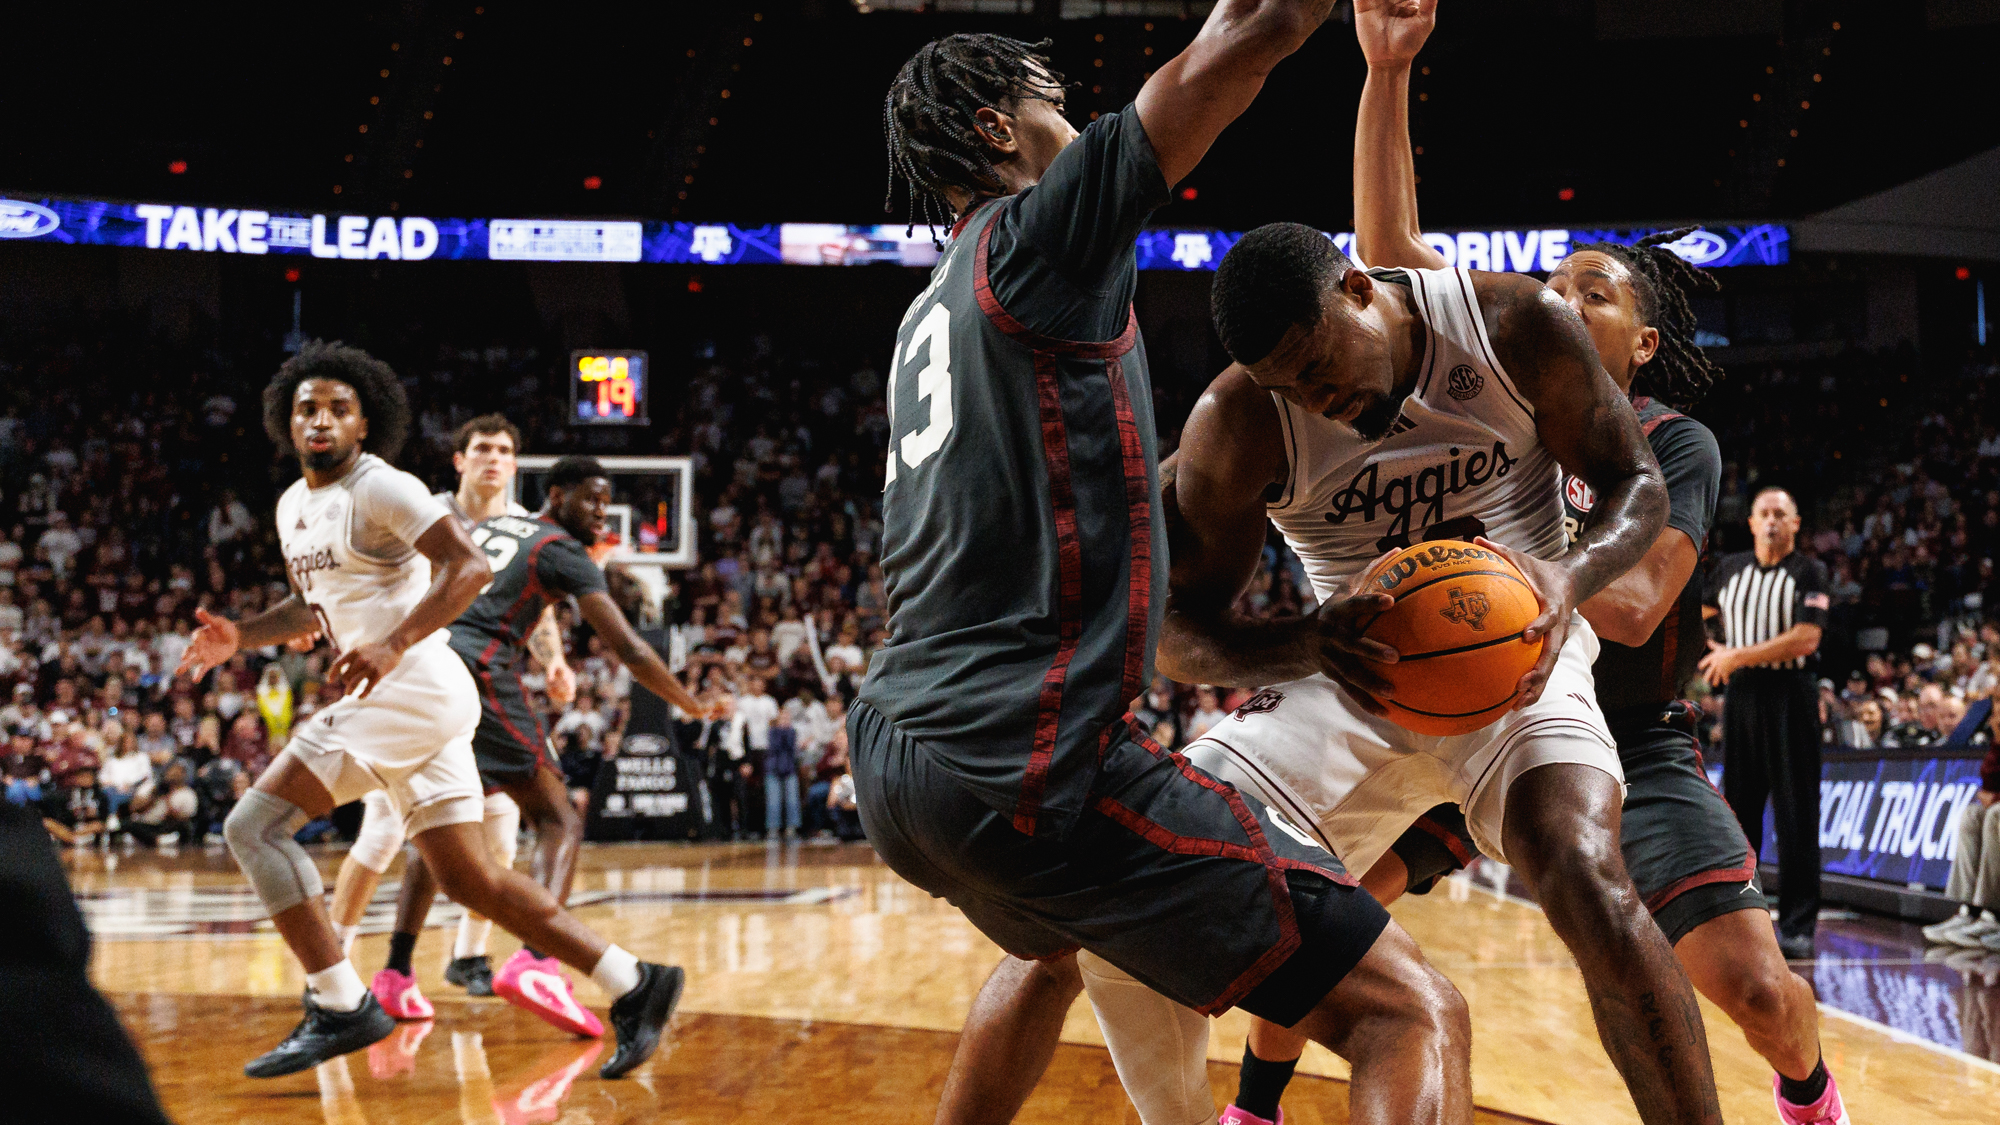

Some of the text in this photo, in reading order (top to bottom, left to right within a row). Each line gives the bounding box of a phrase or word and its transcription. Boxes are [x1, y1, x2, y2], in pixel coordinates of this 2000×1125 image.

[136, 204, 269, 254] TAKE
[269, 218, 310, 246] THE
[311, 213, 439, 260] LEAD
[597, 378, 635, 416] 19
[1451, 367, 1476, 391] SEC
[1325, 440, 1518, 540] Aggies
[1570, 477, 1594, 509] SE
[1377, 545, 1505, 590] Wilson
[1868, 781, 1977, 861] TRUCK
